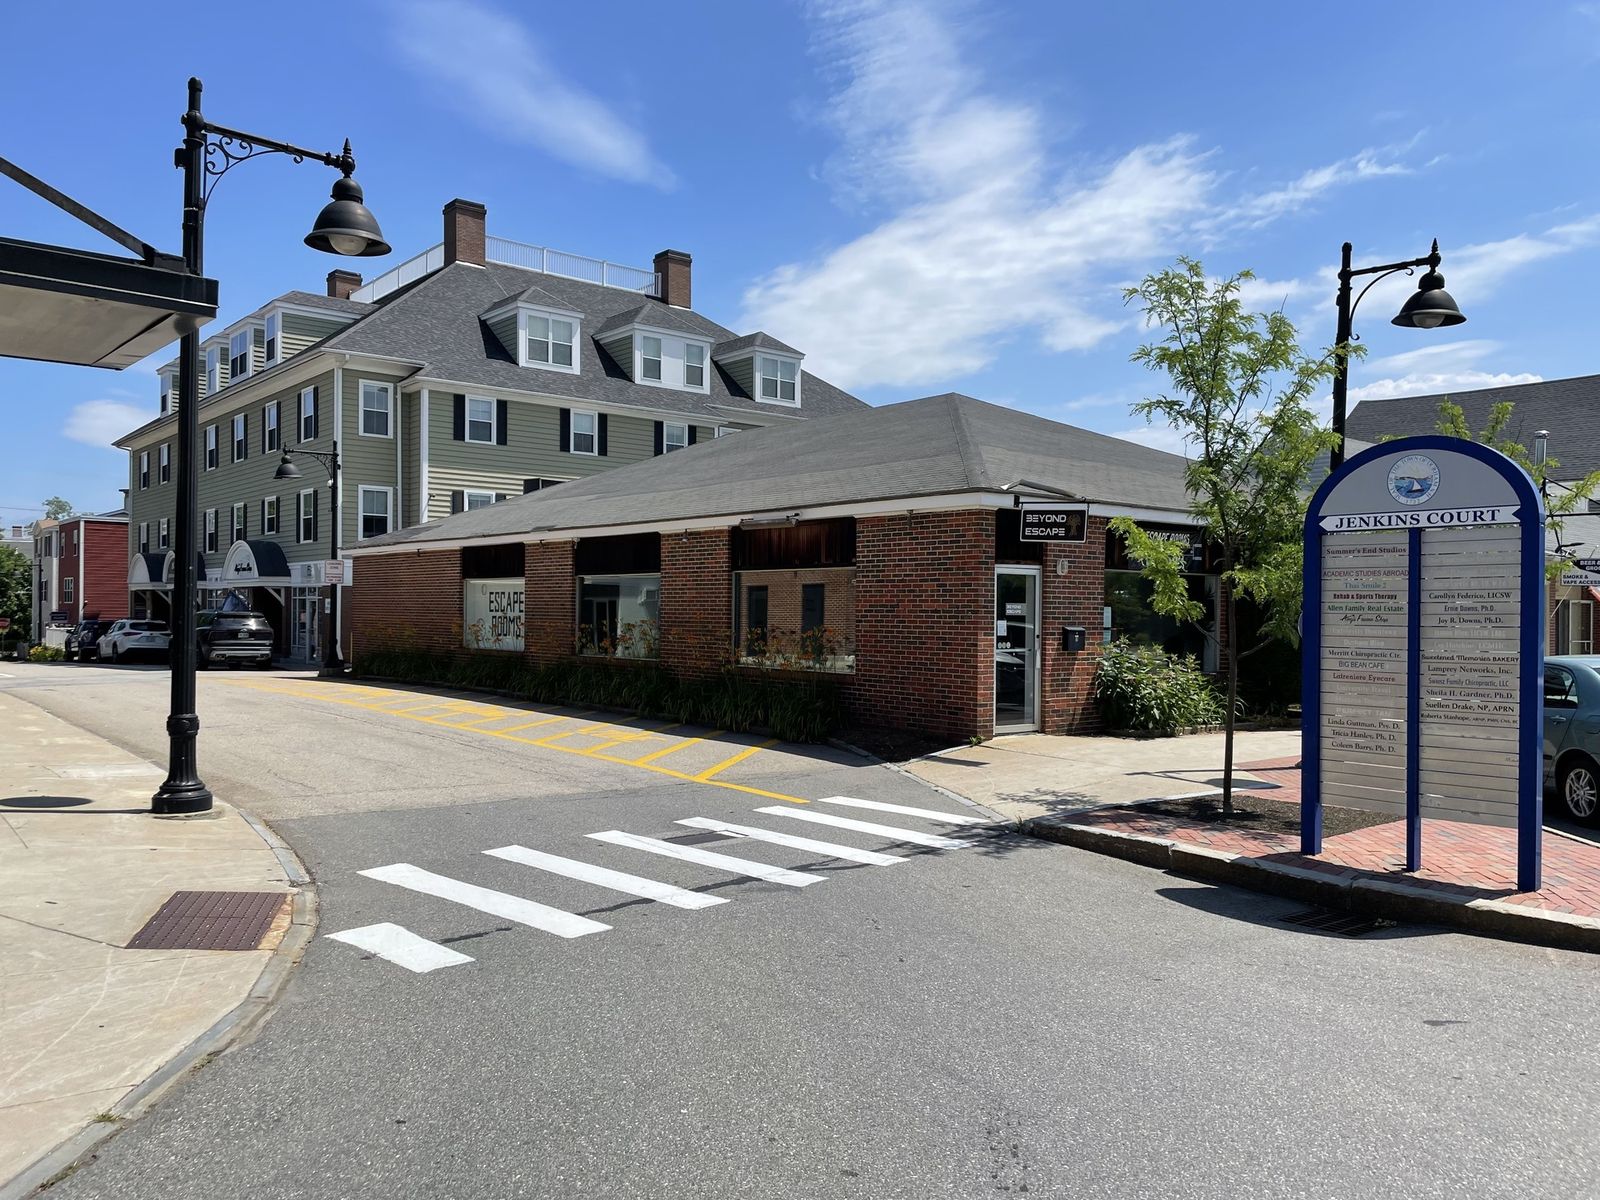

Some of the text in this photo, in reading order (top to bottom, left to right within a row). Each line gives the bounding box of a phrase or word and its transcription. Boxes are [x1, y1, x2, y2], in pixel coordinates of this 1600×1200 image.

[1026, 514, 1066, 522] BEYOND
[1336, 509, 1500, 529] JENKINS COURT
[1025, 528, 1065, 536] ESCAPE
[1326, 547, 1360, 555] Summer's
[1378, 546, 1407, 554] Studios
[1323, 570, 1355, 578] ACADEMIC
[1383, 569, 1409, 577] ABROAD
[489, 591, 524, 613] ESCAPE
[1327, 604, 1343, 612] Allen
[1345, 604, 1365, 612] Family
[1438, 617, 1448, 625] Joy
[491, 615, 521, 639] ROOMS
[1338, 660, 1350, 668] BIG
[1428, 665, 1457, 673] Lamprey
[1368, 674, 1396, 682] Eyecare
[1460, 690, 1492, 699] Gardner,
[1452, 703, 1475, 711] Drake,
[1477, 704, 1491, 712] NP,
[1492, 705, 1515, 713] APRN
[1331, 729, 1349, 737] Tricia
